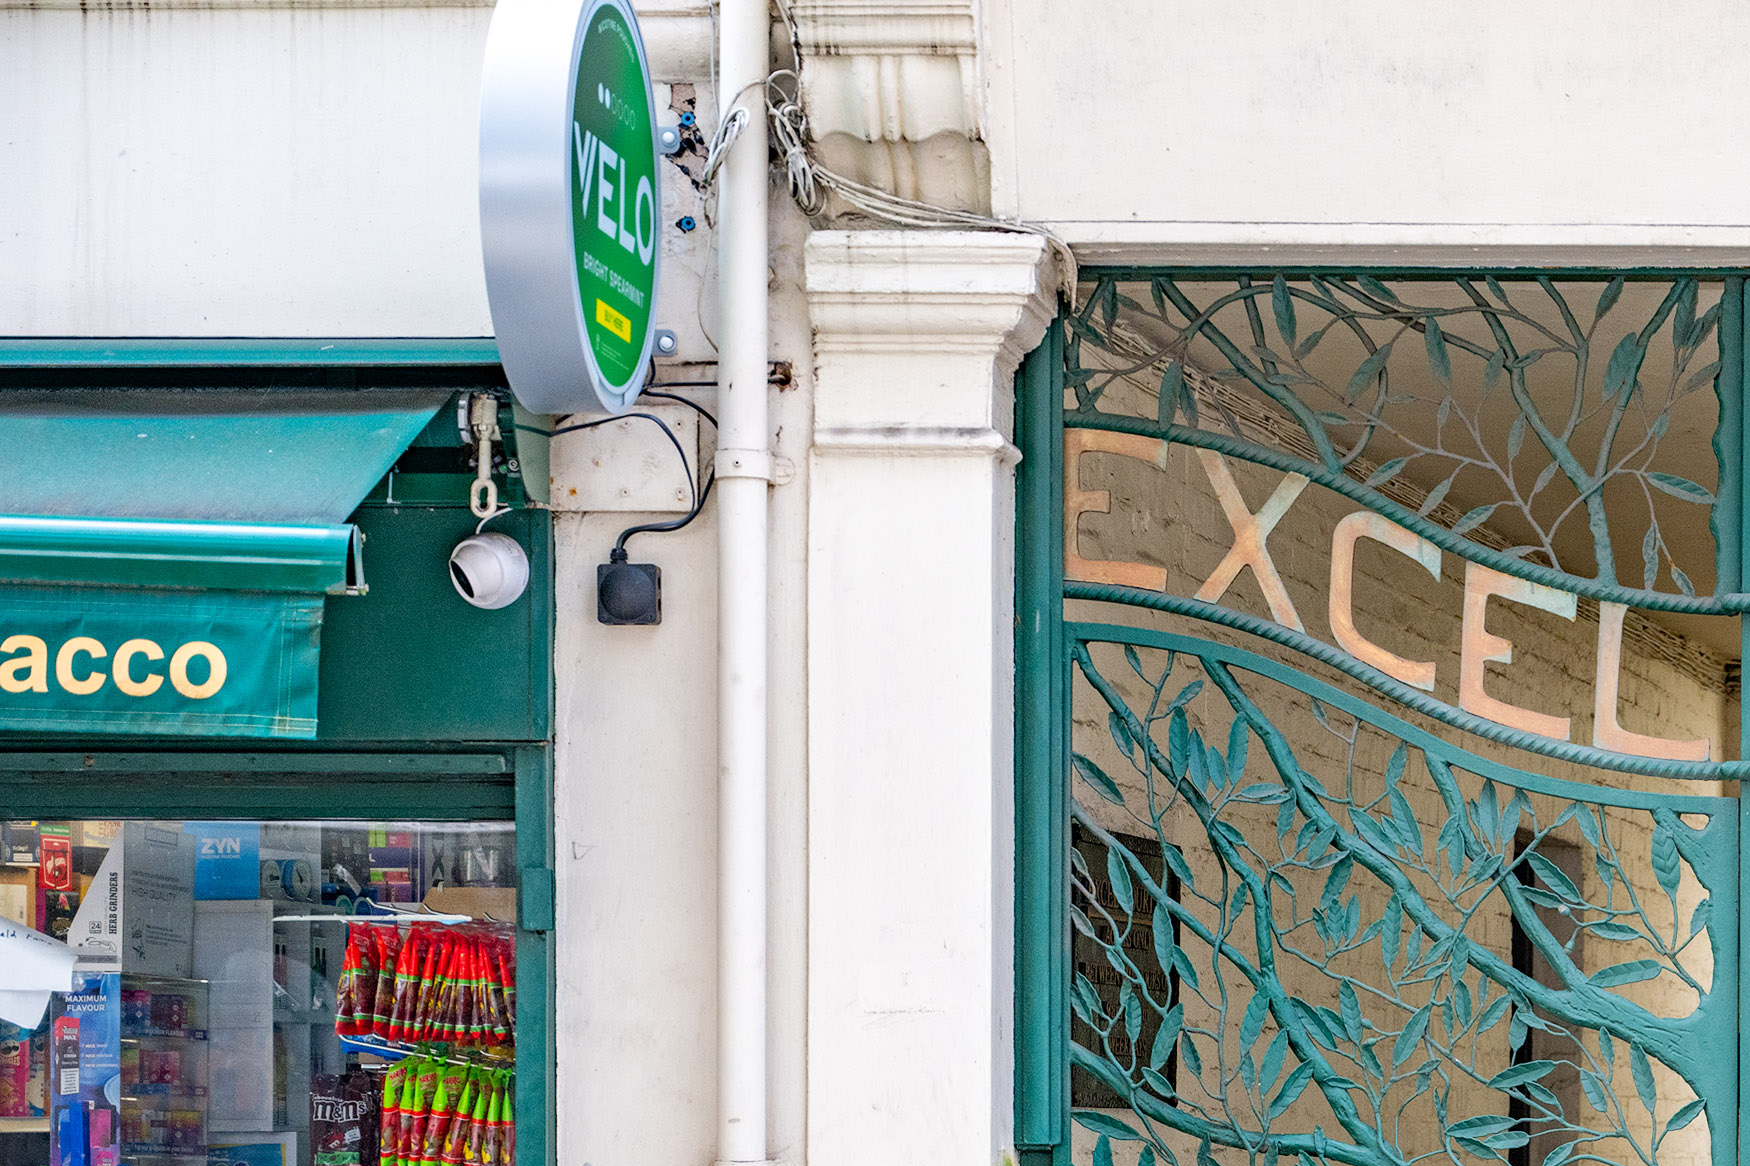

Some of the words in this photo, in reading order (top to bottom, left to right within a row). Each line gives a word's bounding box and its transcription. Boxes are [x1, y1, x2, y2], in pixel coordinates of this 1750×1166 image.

[573, 120, 655, 267] VELO
[583, 251, 609, 283] BRIGHT
[609, 269, 645, 309] SPEARMINT
[1064, 428, 1712, 762] EXCEL
[0, 634, 228, 699] acco
[201, 837, 241, 853] ZYN
[108, 872, 119, 913] GRINDERS
[108, 913, 118, 935] HERB
[65, 995, 107, 1003] MAXIMUM
[66, 1004, 105, 1012] FLAVOUR
